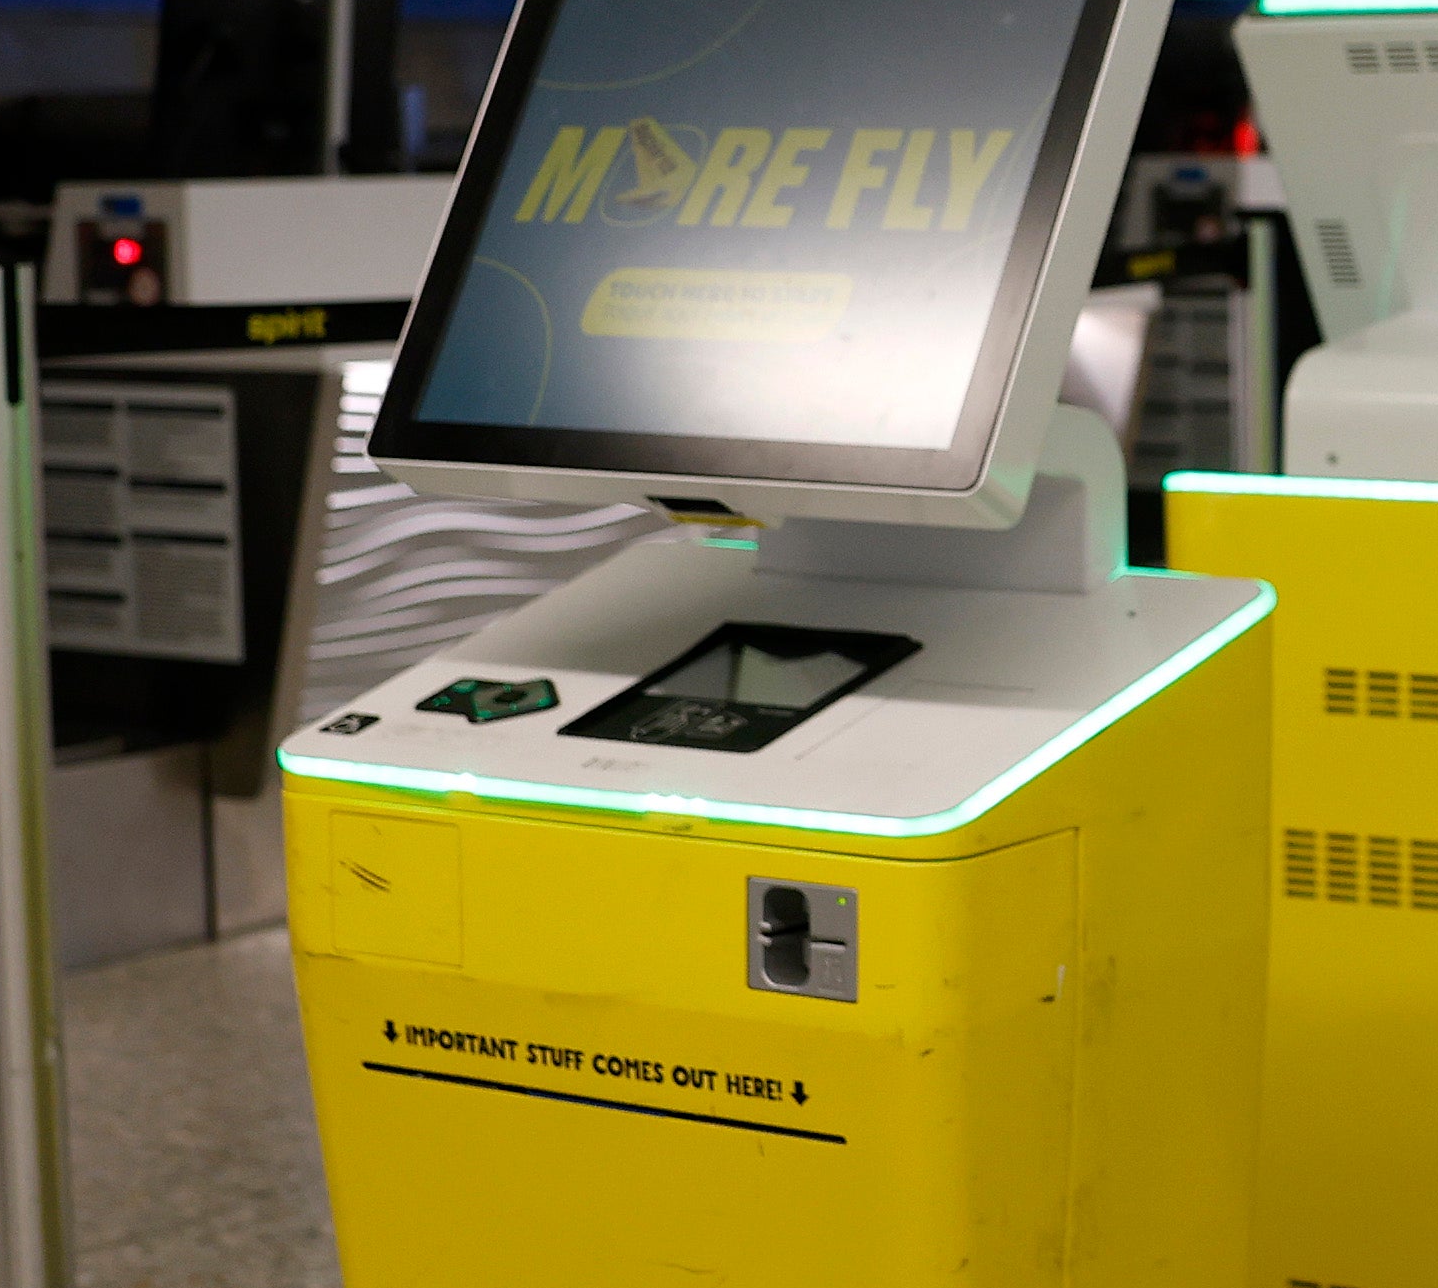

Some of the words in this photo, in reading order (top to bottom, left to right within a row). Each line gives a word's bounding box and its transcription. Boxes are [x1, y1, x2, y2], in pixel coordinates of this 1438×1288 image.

[515, 119, 833, 230] MORE
[825, 129, 1014, 232] FLY
[405, 1024, 517, 1063] IMPORTANT
[526, 1043, 584, 1073] STUFF
[592, 1053, 665, 1086] COMES
[672, 1064, 716, 1094] OUT
[725, 1072, 783, 1104] HERE!
